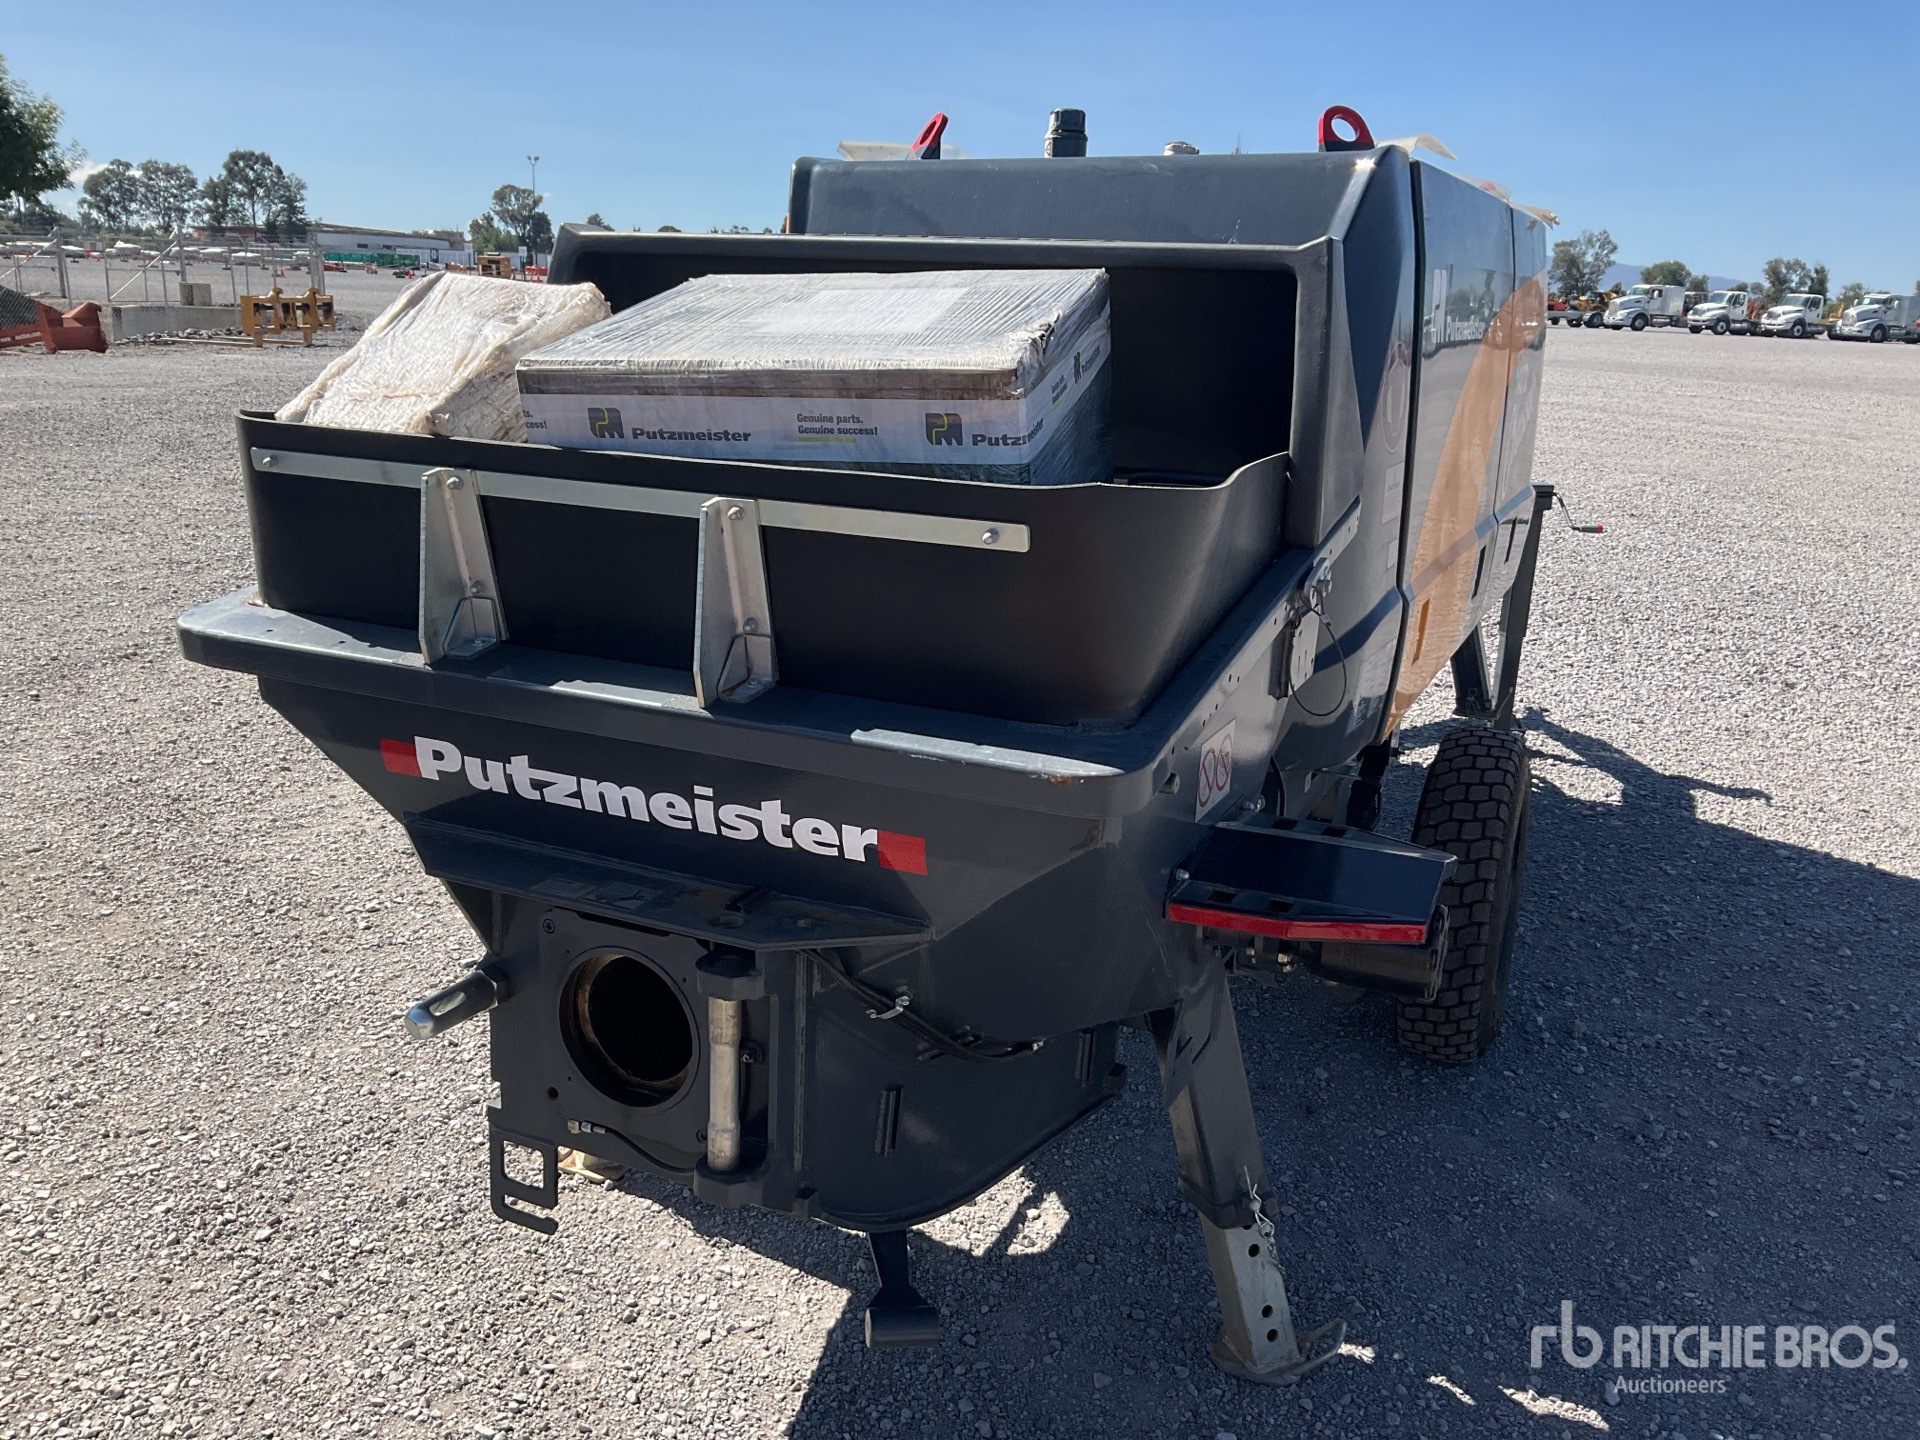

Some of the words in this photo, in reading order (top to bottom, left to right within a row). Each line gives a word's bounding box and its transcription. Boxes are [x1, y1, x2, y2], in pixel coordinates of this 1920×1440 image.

[525, 420, 548, 429] cess!
[797, 413, 834, 424] Genuine
[836, 414, 864, 426] parts.
[631, 427, 751, 442] Putzmeister
[798, 425, 835, 435] Genuine
[837, 426, 878, 436] success!
[414, 735, 878, 862] Putzmeister
